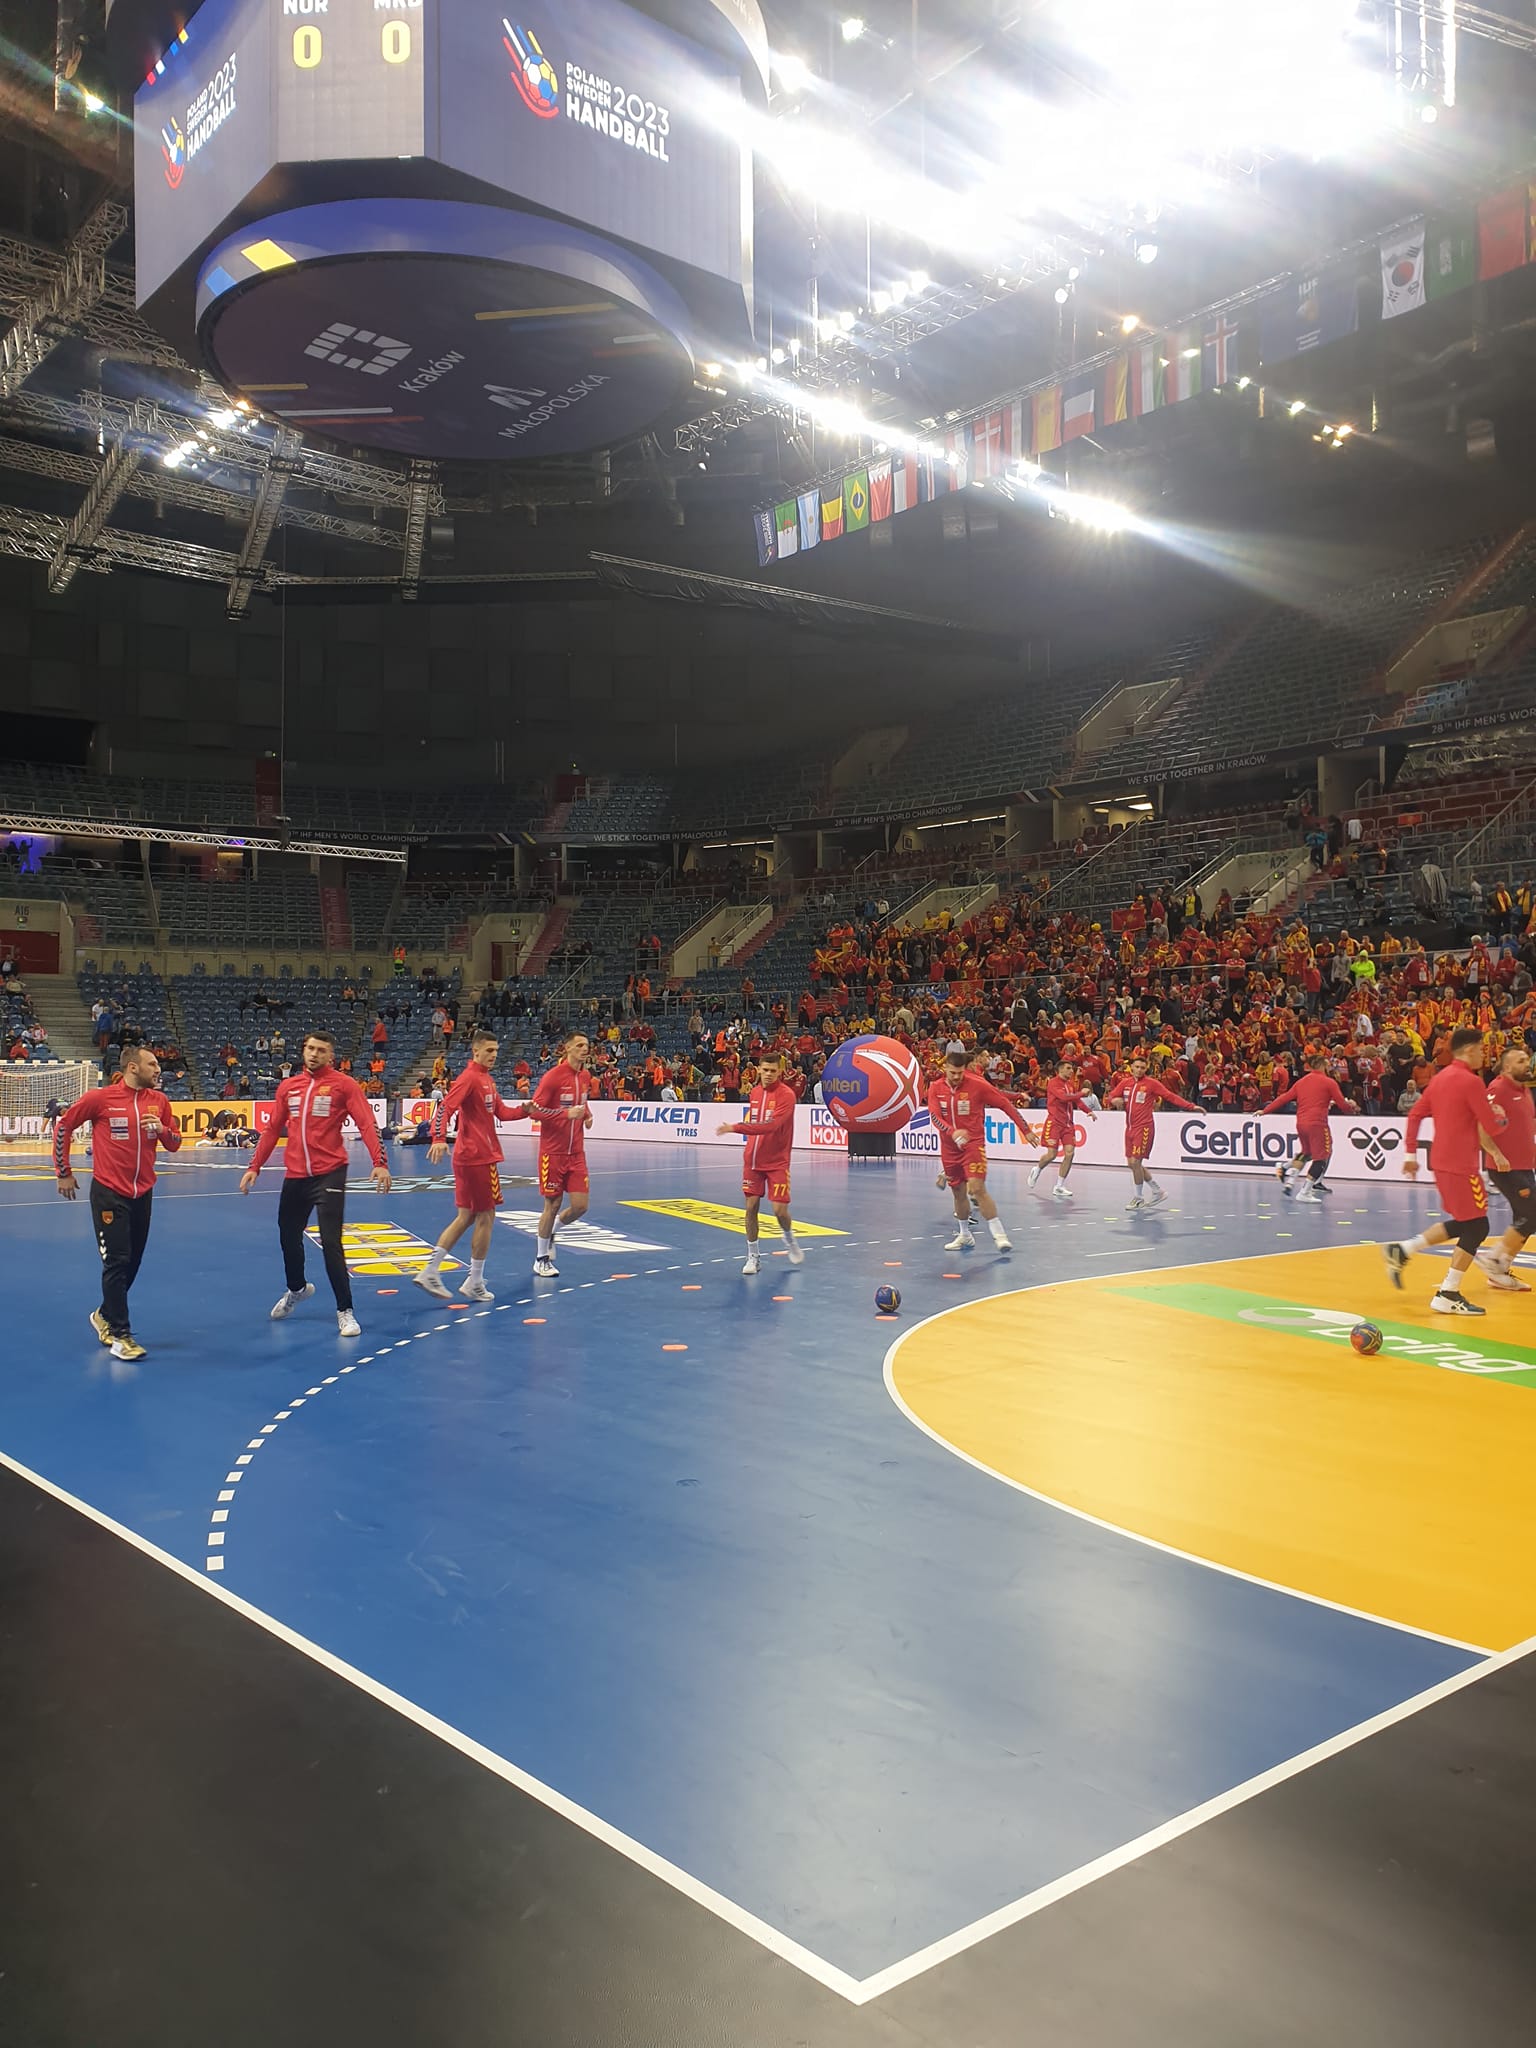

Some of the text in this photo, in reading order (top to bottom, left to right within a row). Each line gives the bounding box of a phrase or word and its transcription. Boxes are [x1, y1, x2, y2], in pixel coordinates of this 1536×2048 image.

[293, 25, 323, 68] 0
[382, 20, 411, 64] 0
[208, 52, 237, 109] 2023
[566, 61, 612, 94] POLAND
[566, 76, 612, 110] SWEDEN
[187, 88, 208, 121] POLAND
[187, 102, 208, 135] SWEDEN
[613, 86, 670, 136] 2023
[187, 86, 237, 162] HANDBALL
[566, 92, 670, 163] HANDBALL
[398, 349, 467, 393] Kraków
[498, 373, 611, 439] MAŁOPOLSKA
[1455, 718, 1471, 730] IHF
[1474, 712, 1506, 727] MEN'S
[1509, 707, 1536, 721] WOR
[1127, 755, 1267, 785] WE STICK TOGETHER IN KRAKÓW
[850, 817, 862, 825] IHF
[863, 815, 885, 824] MEN'S
[886, 812, 911, 822] WORLD
[911, 805, 963, 820] CHAMPIONSHIP
[314, 831, 339, 839] MEN'S
[340, 832, 369, 841] WORLD
[371, 833, 429, 843] CHAMPIONSHIP
[632, 833, 670, 841] TOGETHER
[616, 1106, 701, 1124] FALKEN
[811, 1109, 841, 1127] LIQ
[677, 1128, 698, 1137] TYRES
[811, 1127, 848, 1145] MOLY
[901, 1132, 938, 1151] NOCCO
[1180, 1119, 1299, 1161] Gerflor
[773, 1183, 787, 1198] 77
